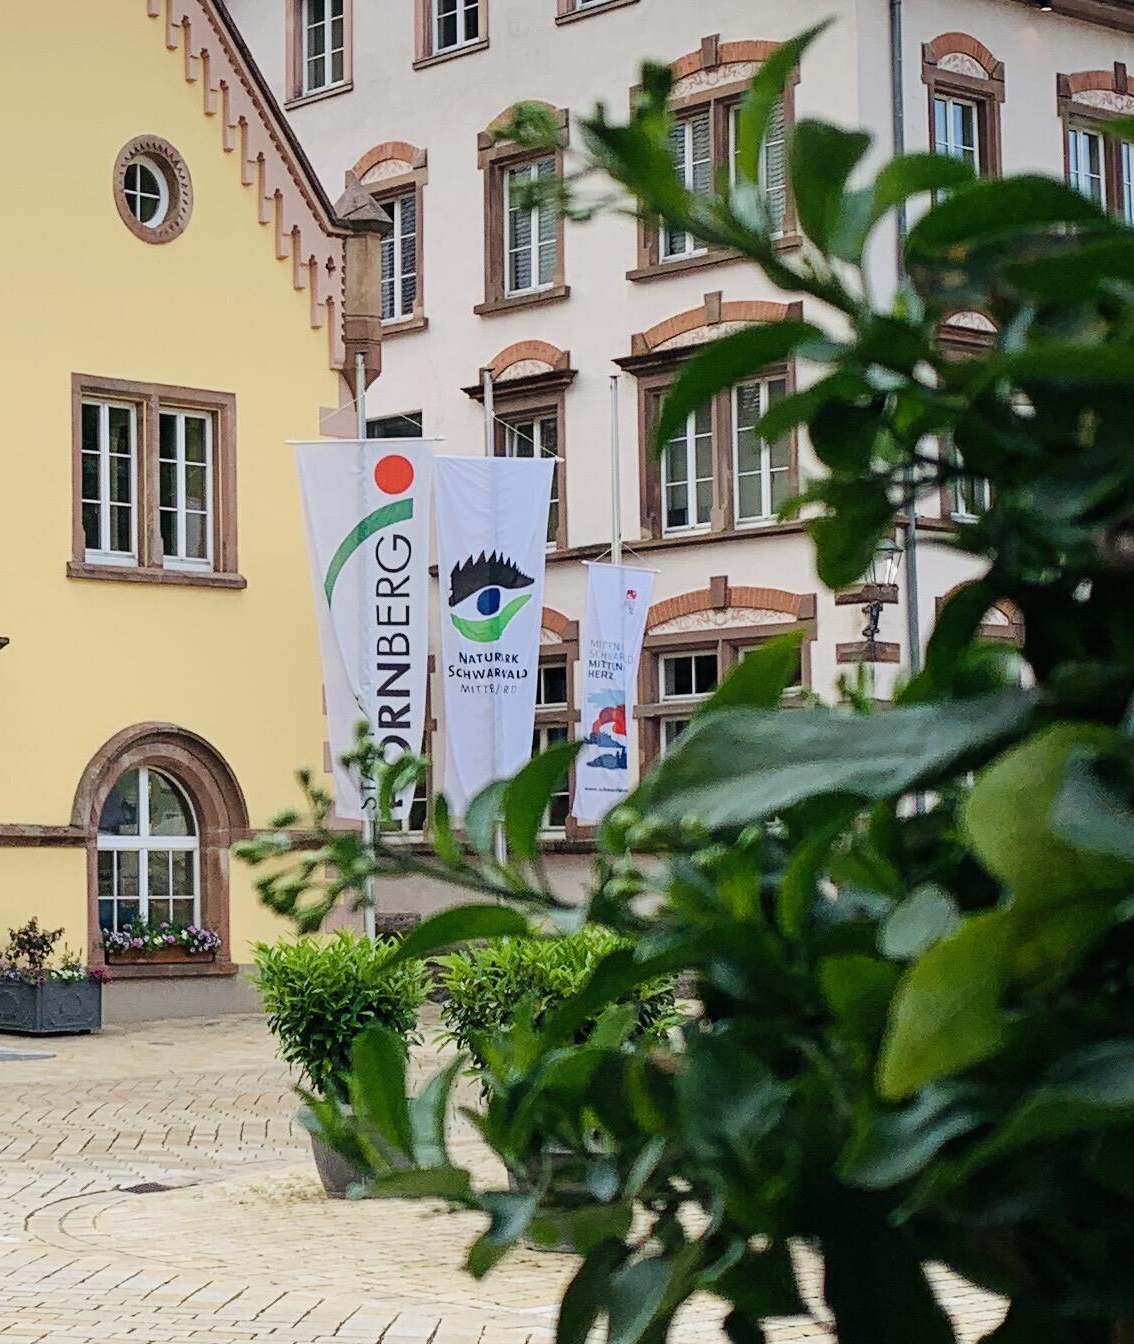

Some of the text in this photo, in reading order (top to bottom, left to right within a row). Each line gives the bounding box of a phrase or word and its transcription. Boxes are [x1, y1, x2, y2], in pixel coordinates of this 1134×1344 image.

[458, 651, 519, 665] NATURRK
[589, 659, 623, 671] MITTEN
[375, 534, 412, 809] ORNBERG
[448, 664, 528, 679] SCHWARALD
